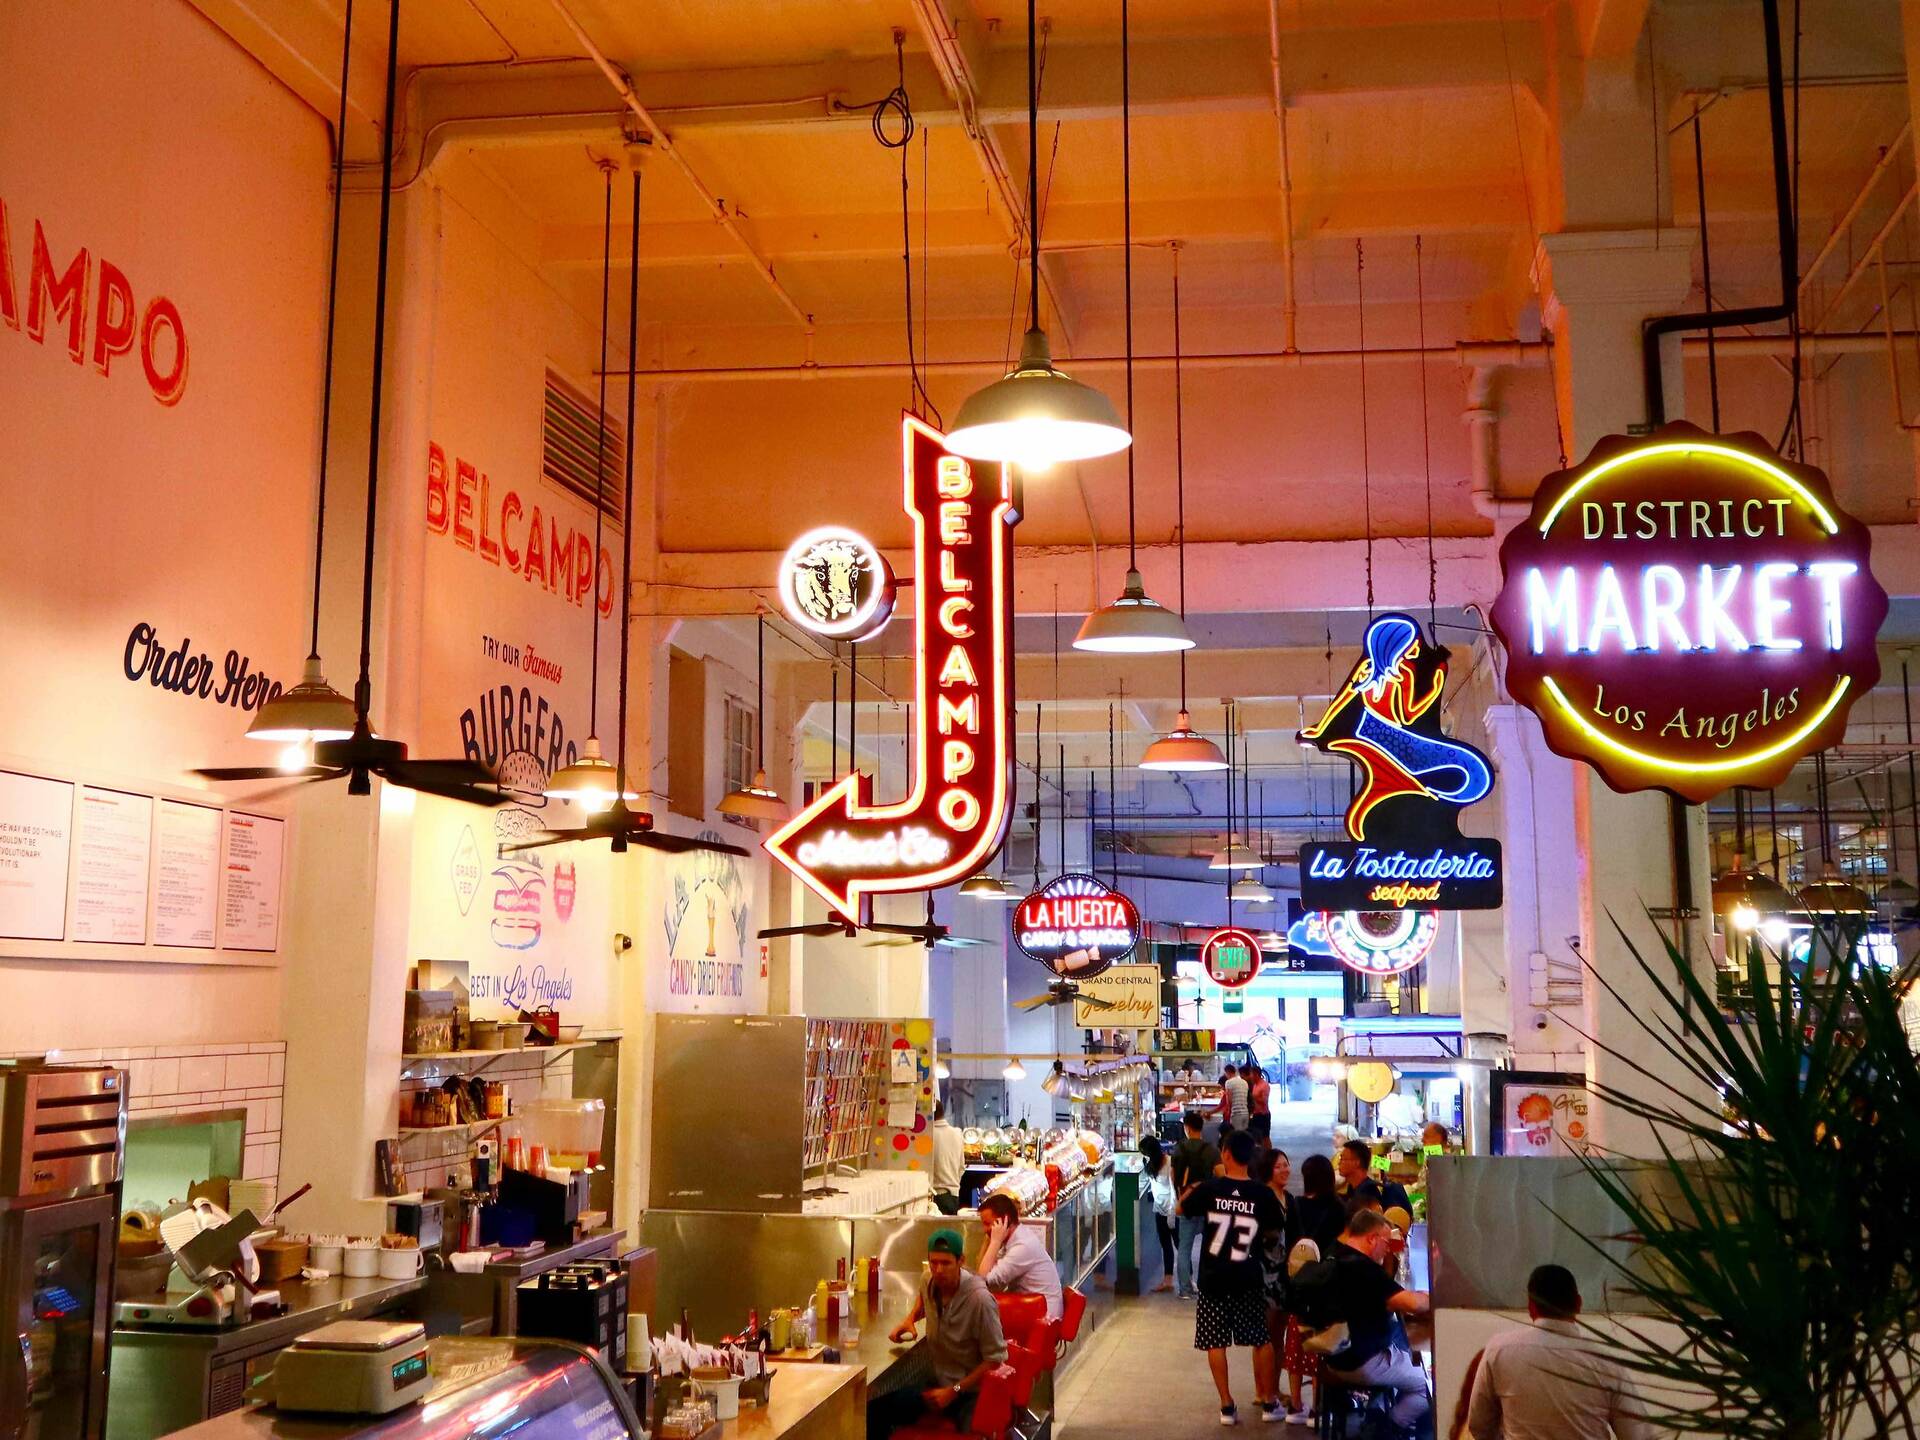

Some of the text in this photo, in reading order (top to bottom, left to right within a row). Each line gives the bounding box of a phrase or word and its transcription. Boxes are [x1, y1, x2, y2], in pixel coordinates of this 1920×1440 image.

[426, 440, 615, 619] BELCAMPO
[1582, 499, 1792, 539] DISTRICT
[1527, 562, 1858, 655] MARKET
[937, 456, 981, 832] BELCAMPO
[123, 622, 215, 699] Order
[482, 635, 562, 684] TRY OUR Famous
[1593, 684, 1800, 748] Los Angeles
[1308, 849, 1346, 879] La
[1371, 881, 1442, 908] seafood
[1025, 899, 1127, 927] LA HUERTA
[1021, 930, 1065, 947] CANDY
[1078, 928, 1132, 946] SNACKS
[1218, 947, 1245, 969] EXIT
[1291, 959, 1306, 968] E-5
[1372, 951, 1391, 969] &
[470, 964, 573, 1012] BEST IN Los Angeles
[1081, 976, 1153, 985] GRAND CENTRAL
[897, 1050, 911, 1068] A
[1215, 1198, 1255, 1214] TOFFOLI
[1207, 1211, 1259, 1262] 73
